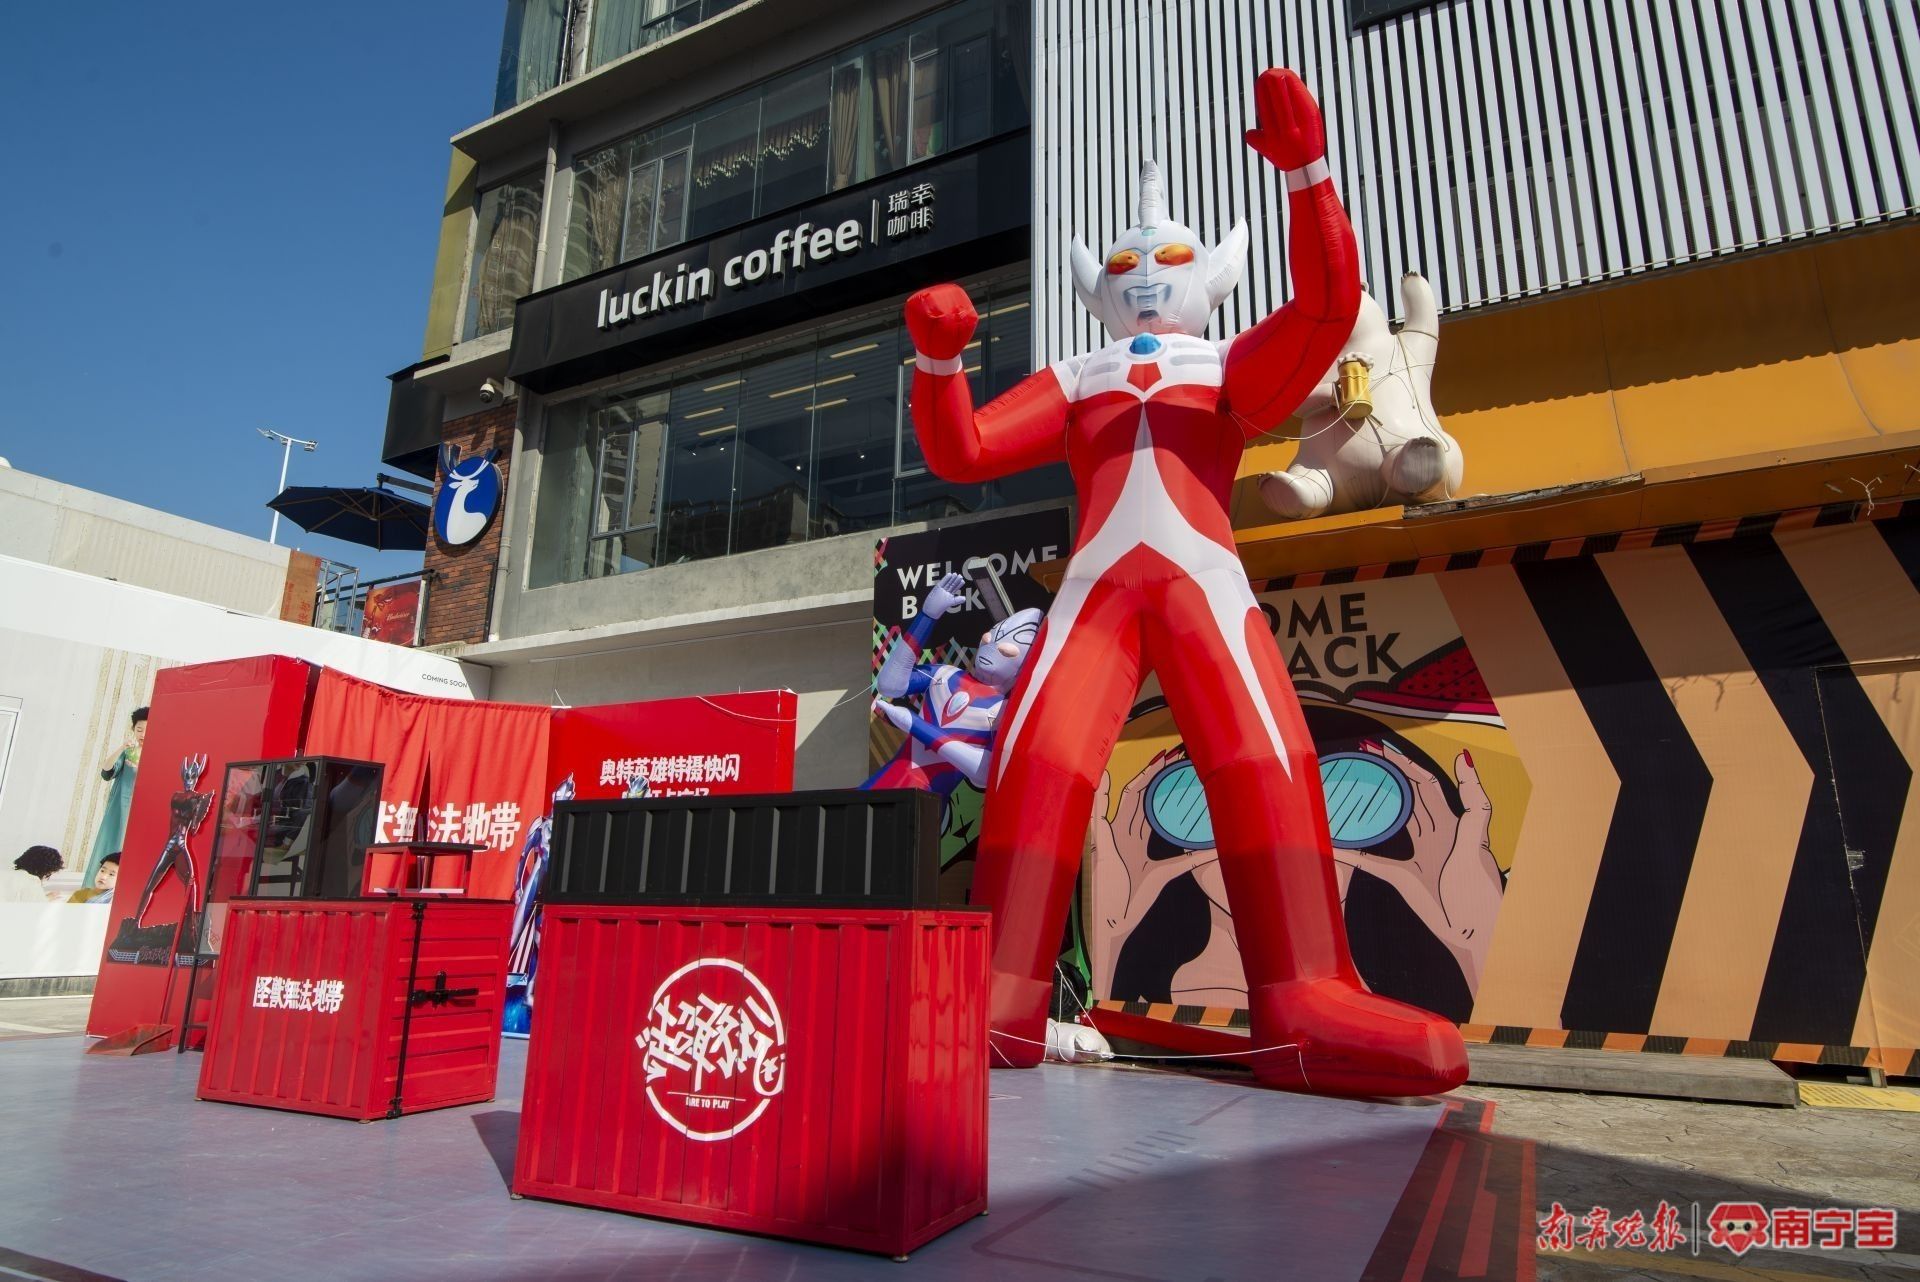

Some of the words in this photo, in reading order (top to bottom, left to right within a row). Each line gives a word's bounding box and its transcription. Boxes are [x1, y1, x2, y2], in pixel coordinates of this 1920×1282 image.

[888, 183, 935, 213] 瑞幸
[887, 206, 934, 236] 咖啡
[597, 263, 714, 328] luckin
[724, 219, 863, 287] coffee
[902, 586, 986, 620] BK
[421, 673, 448, 685] COMING
[449, 679, 468, 688] SOON
[701, 1098, 711, 1108] TO
[712, 1098, 730, 1109] PLAY
